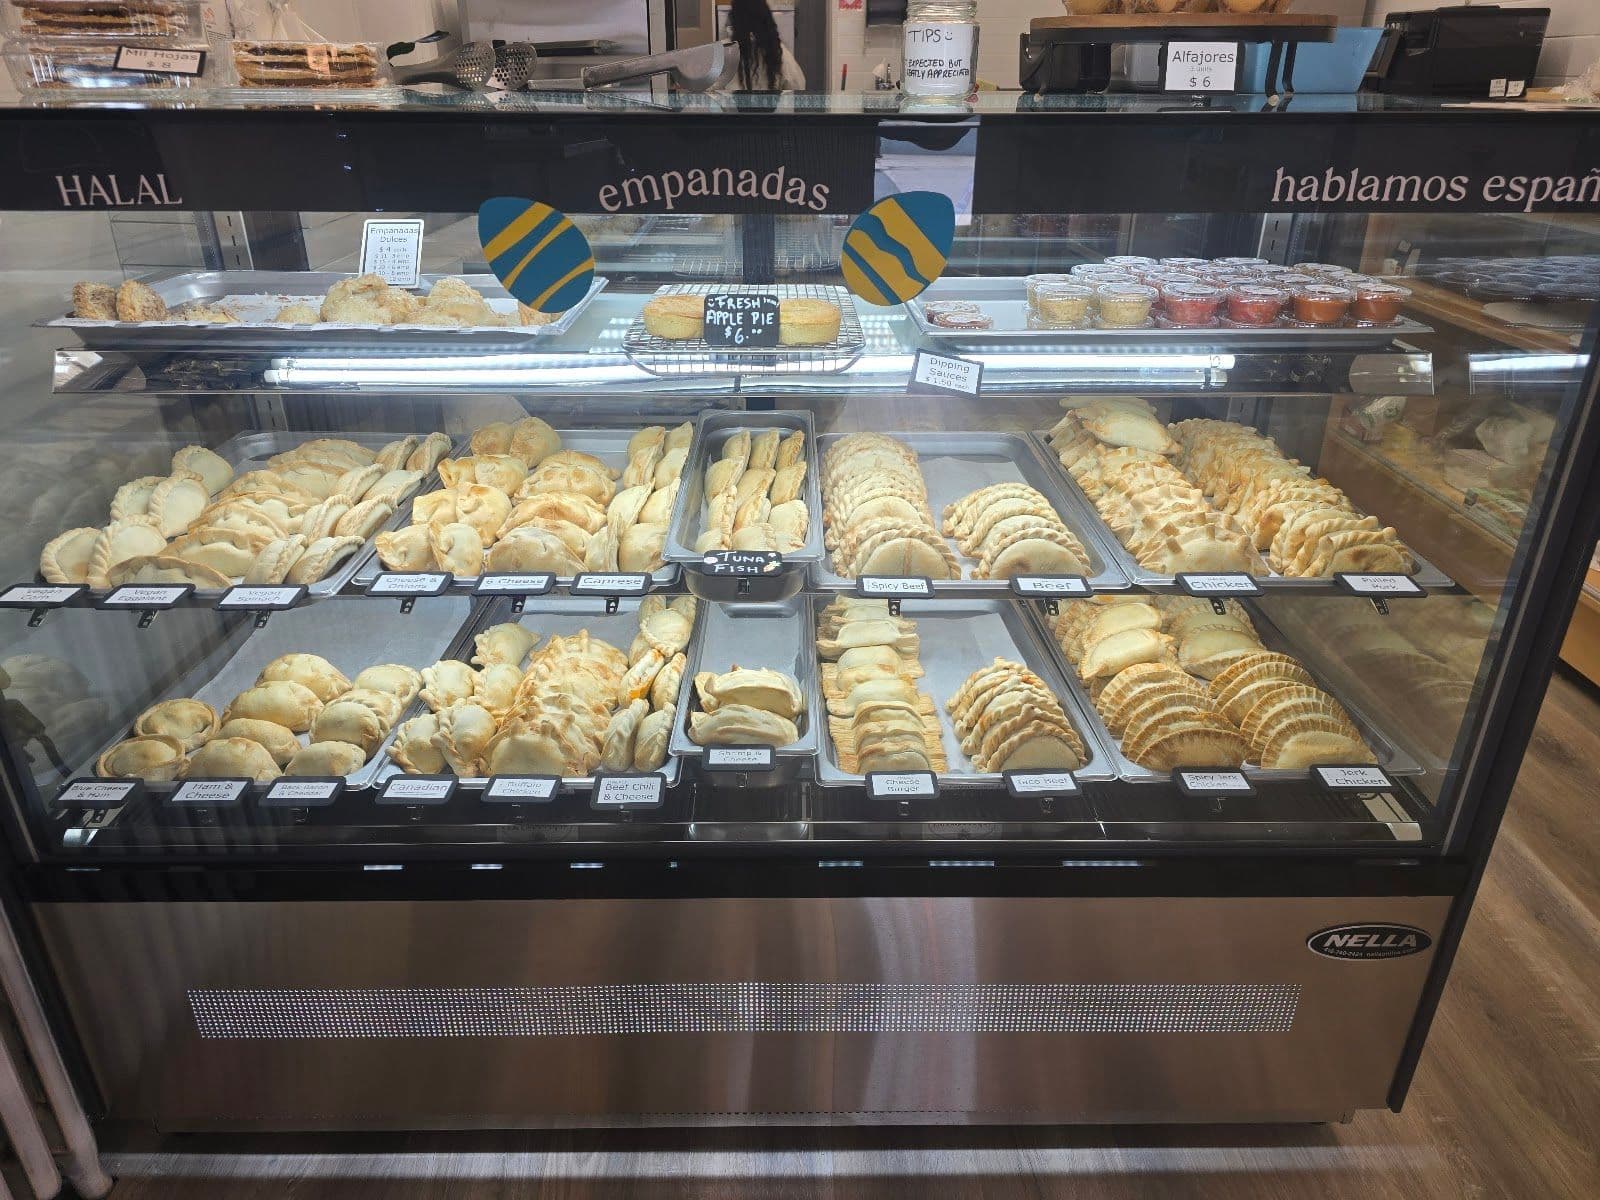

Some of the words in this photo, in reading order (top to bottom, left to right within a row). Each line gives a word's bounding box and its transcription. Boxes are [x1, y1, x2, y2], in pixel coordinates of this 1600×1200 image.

[908, 28, 941, 43] TIPS
[126, 48, 148, 57] Mil
[153, 51, 198, 61] Hojas
[1172, 50, 1234, 65] Alfajores
[908, 58, 944, 68] EXPECTED
[948, 58, 963, 68] BUT
[1189, 75, 1197, 88] $
[1202, 76, 1211, 88] 6
[55, 174, 183, 206] HALAL
[598, 165, 830, 211] empanadas
[1271, 166, 1469, 202] hablamos
[370, 227, 420, 235] Empanadas
[715, 294, 761, 310] FRESH
[705, 309, 744, 326] APPLE
[751, 311, 775, 326] PIE
[930, 357, 970, 374] Dipping
[929, 367, 968, 382] Sauces
[715, 550, 766, 563] TUNA
[713, 563, 759, 574] FISH
[871, 581, 899, 591] Spicy
[902, 582, 925, 590] Beef
[1032, 582, 1072, 590] Beef
[1190, 581, 1253, 590] Chicken
[391, 783, 449, 791] Canadian
[185, 791, 231, 799] Cheese
[603, 793, 612, 801] &
[614, 793, 654, 801] Cheese
[1323, 934, 1417, 948] NELLA
